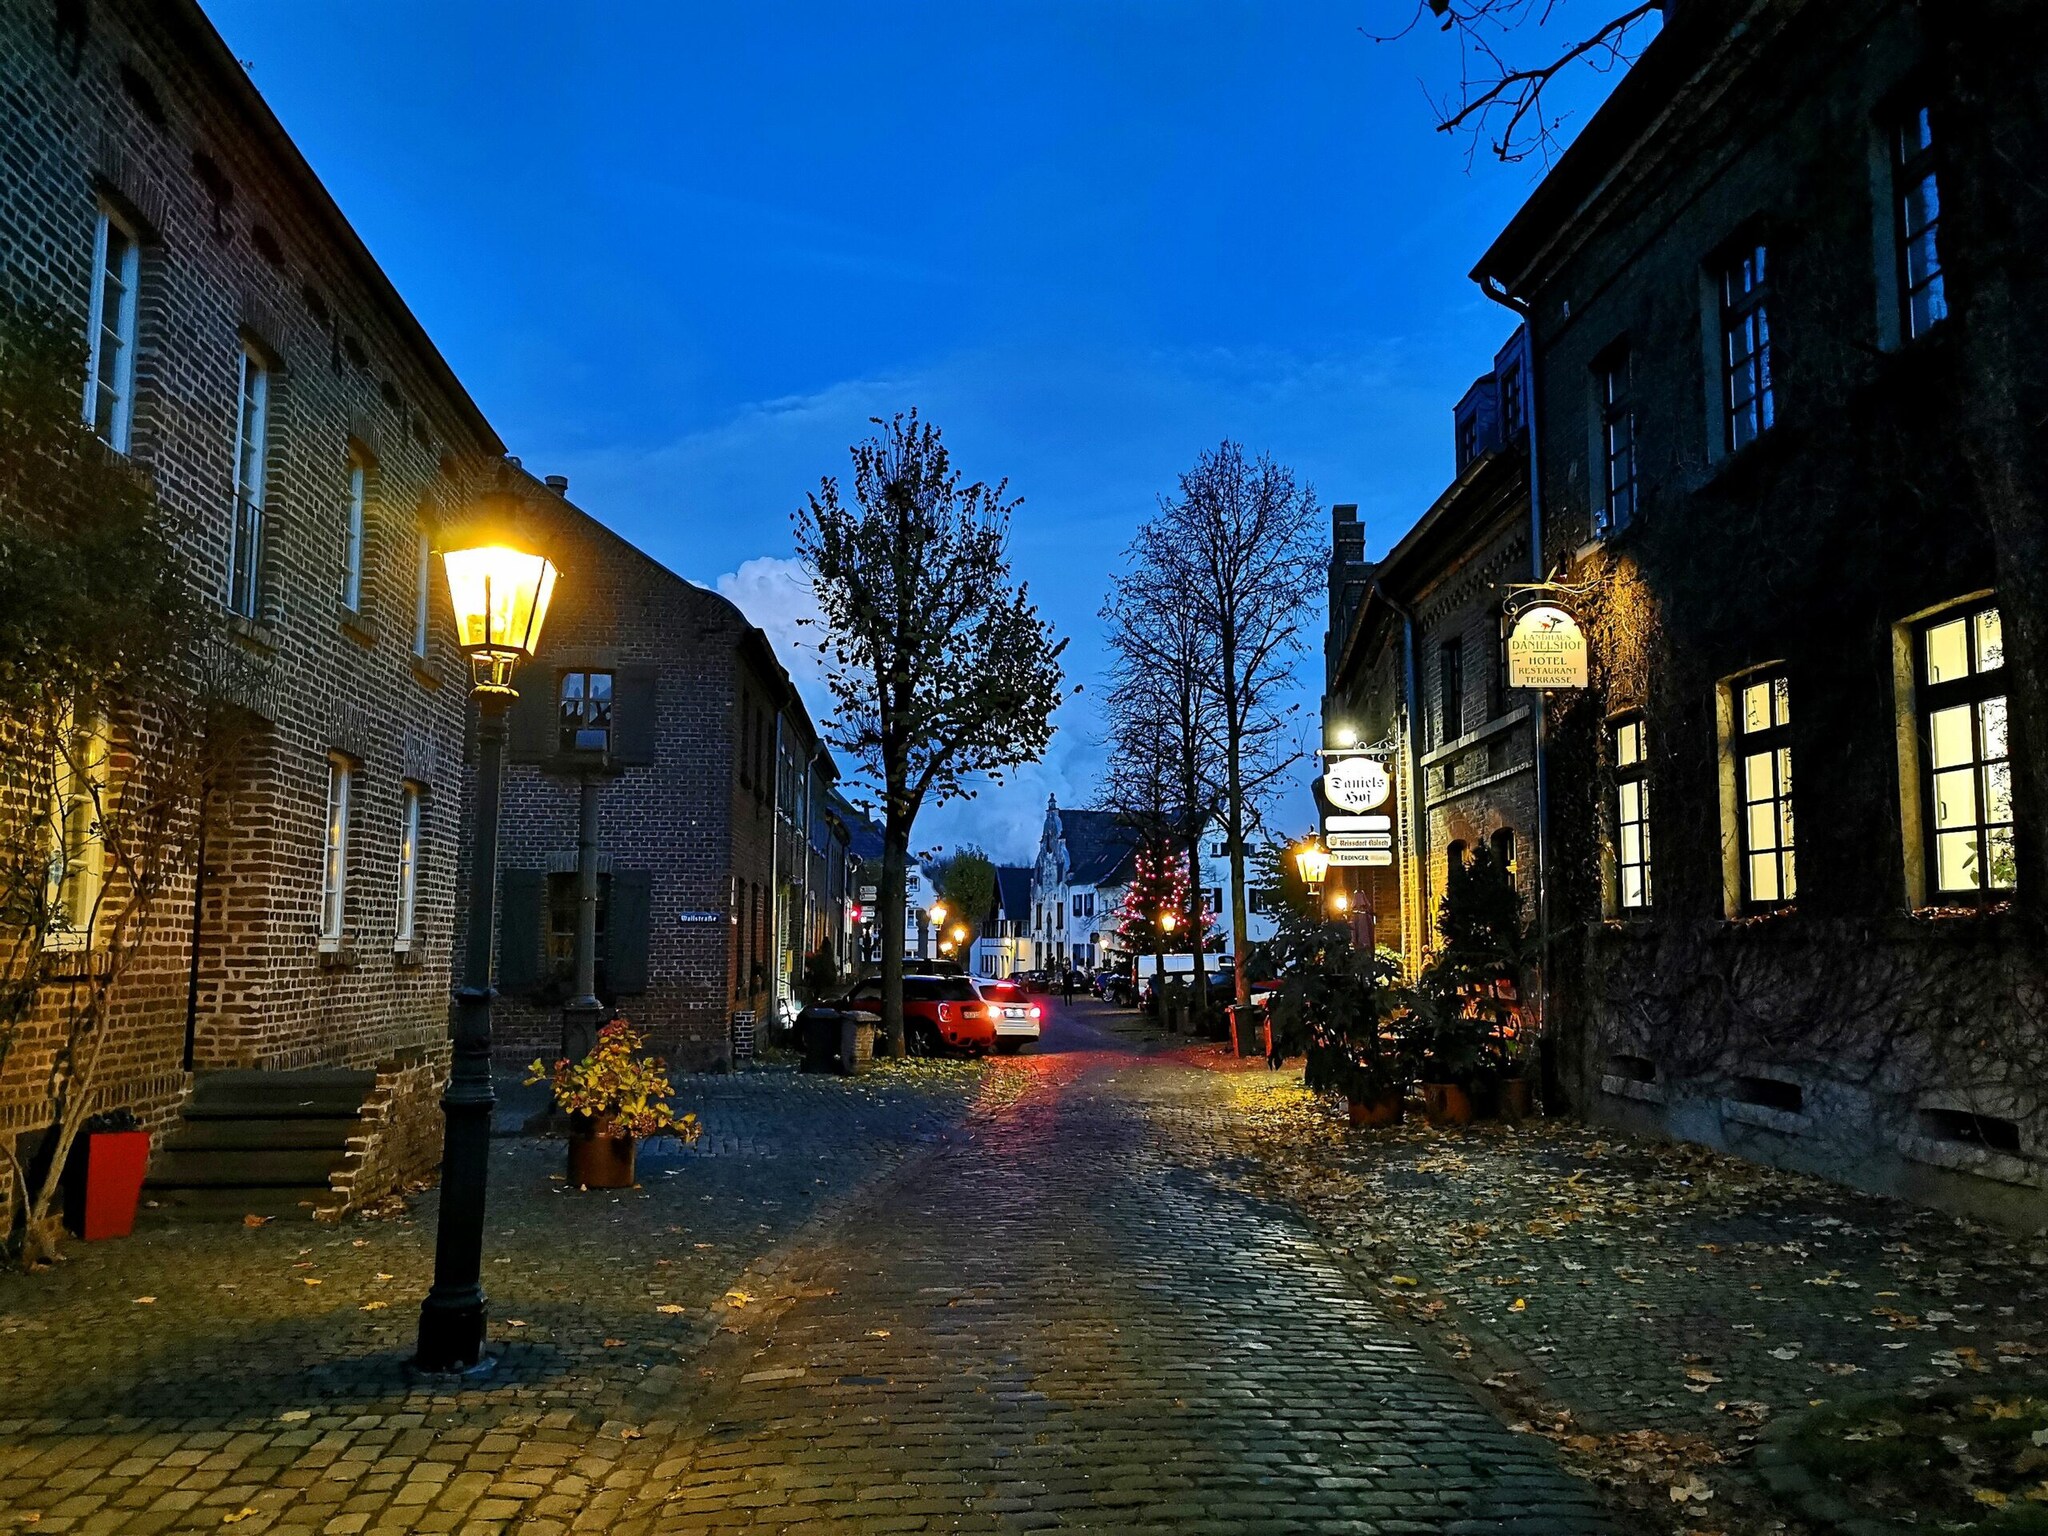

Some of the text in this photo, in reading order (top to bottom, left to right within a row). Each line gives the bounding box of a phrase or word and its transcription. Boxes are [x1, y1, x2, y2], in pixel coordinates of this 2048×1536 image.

[1512, 640, 1584, 650] DANIELSHOF
[1529, 657, 1567, 665] HOTEL
[1525, 676, 1572, 684] TERRASSE
[1331, 776, 1384, 789] Daniels
